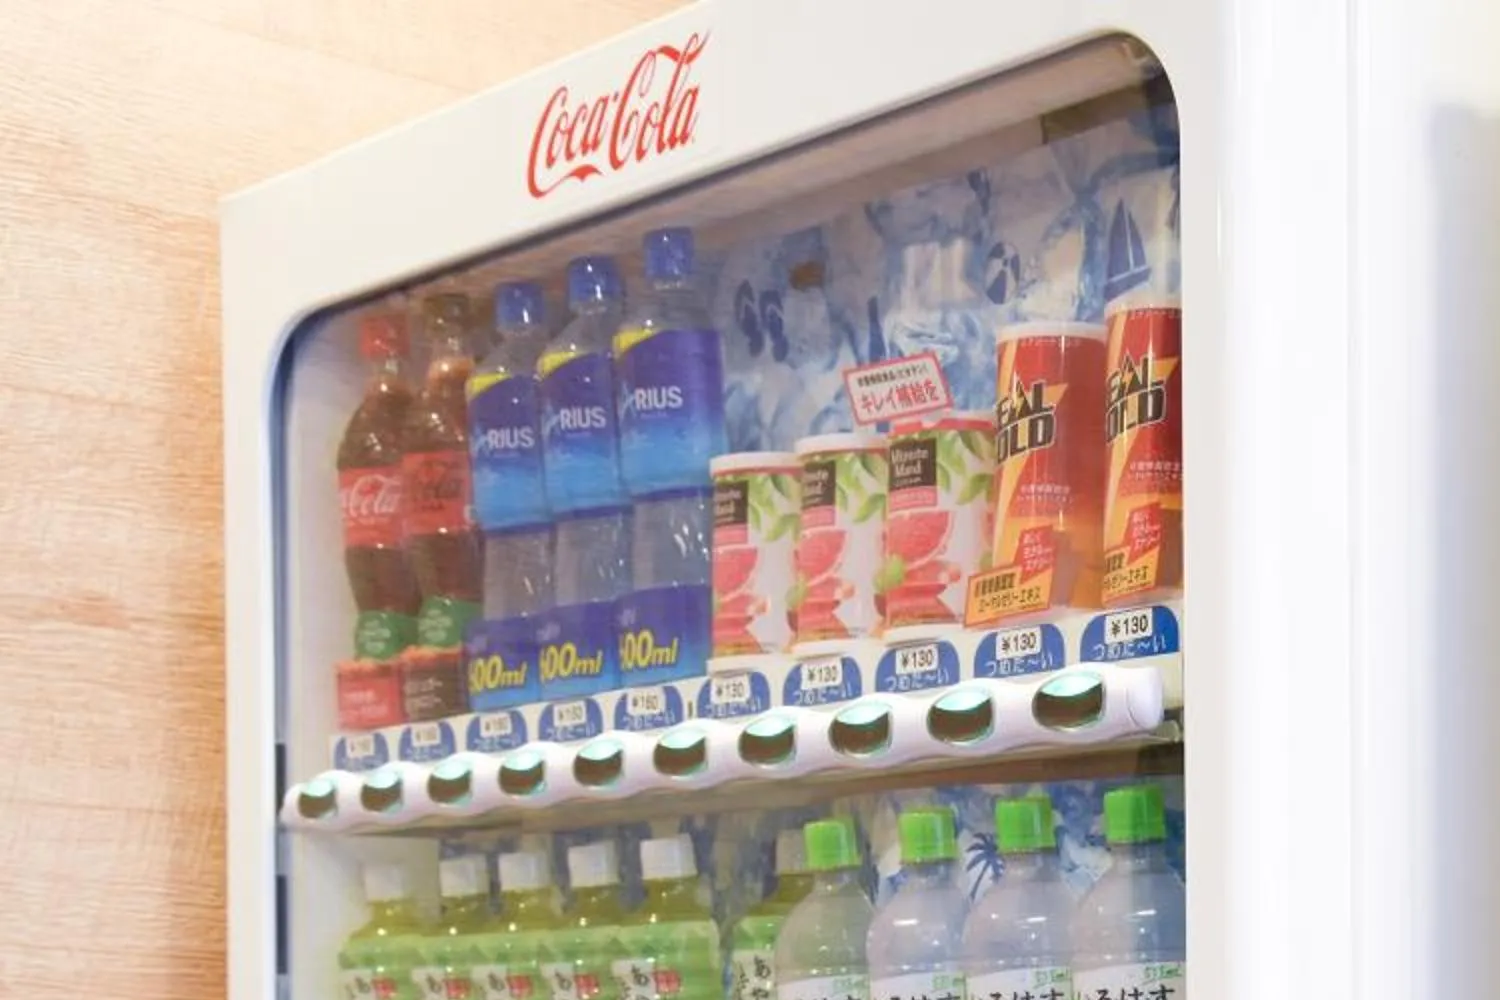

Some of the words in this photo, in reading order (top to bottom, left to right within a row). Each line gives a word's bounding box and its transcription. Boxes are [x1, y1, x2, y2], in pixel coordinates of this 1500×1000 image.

[528, 27, 712, 199] Coca-Cola
[1109, 615, 1148, 637] ¥130
[1001, 633, 1037, 654] ¥130
[901, 649, 933, 669] ¥130
[807, 665, 837, 683] ¥130
[715, 681, 745, 699] ¥130
